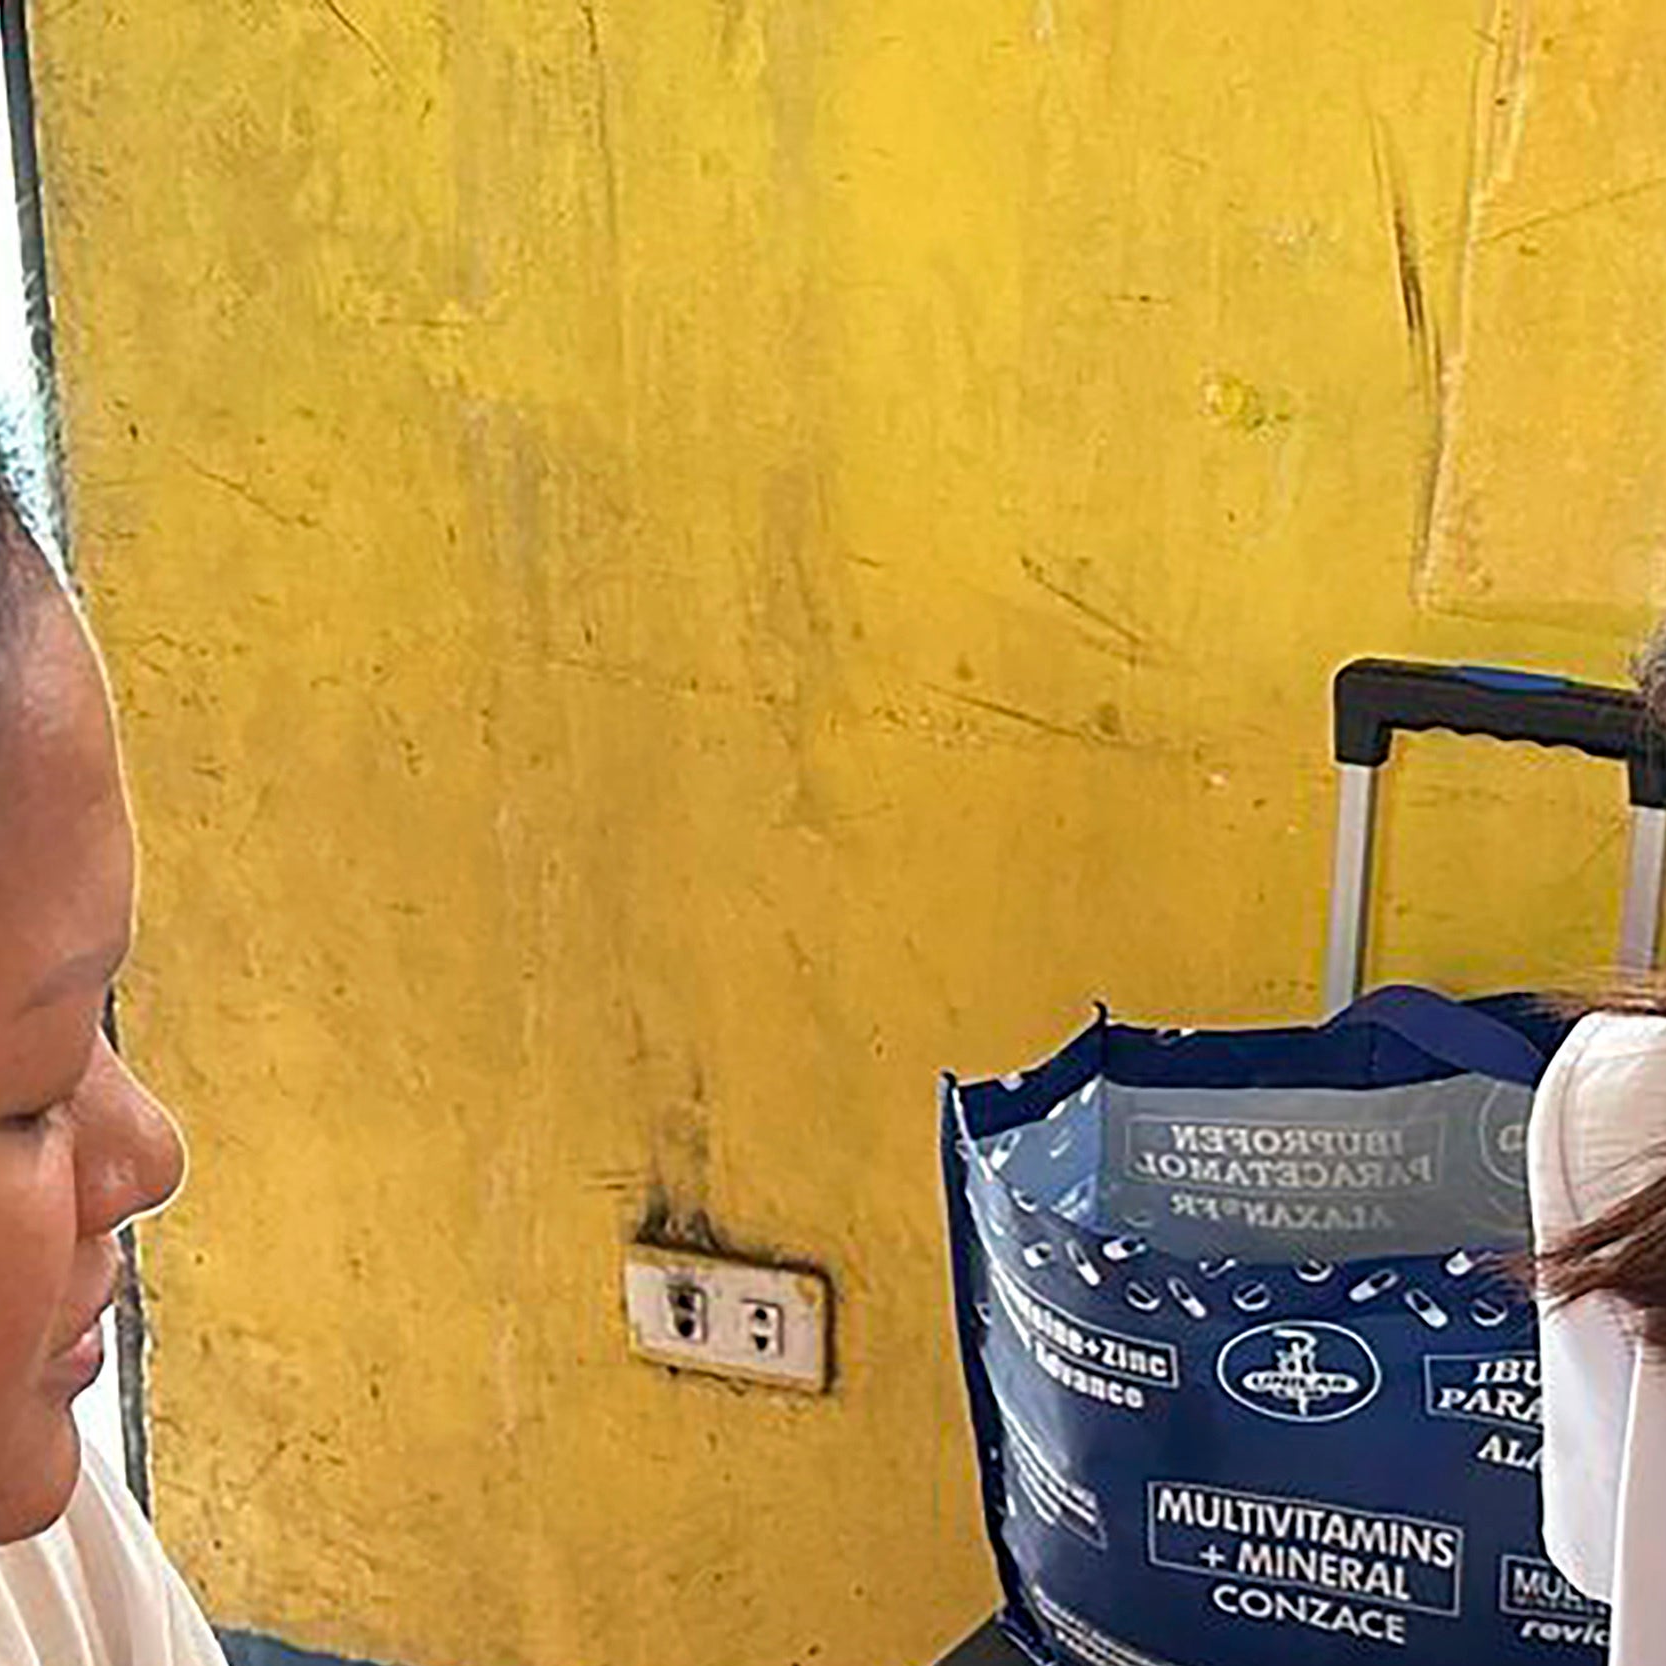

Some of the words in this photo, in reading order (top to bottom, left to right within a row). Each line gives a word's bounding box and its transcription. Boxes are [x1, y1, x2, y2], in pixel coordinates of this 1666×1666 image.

[1156, 1486, 1456, 1567] MULTIVITAMINS
[1200, 1543, 1225, 1568] +
[1236, 1543, 1410, 1602] MINERAL
[1213, 1581, 1406, 1645] CONZACE
